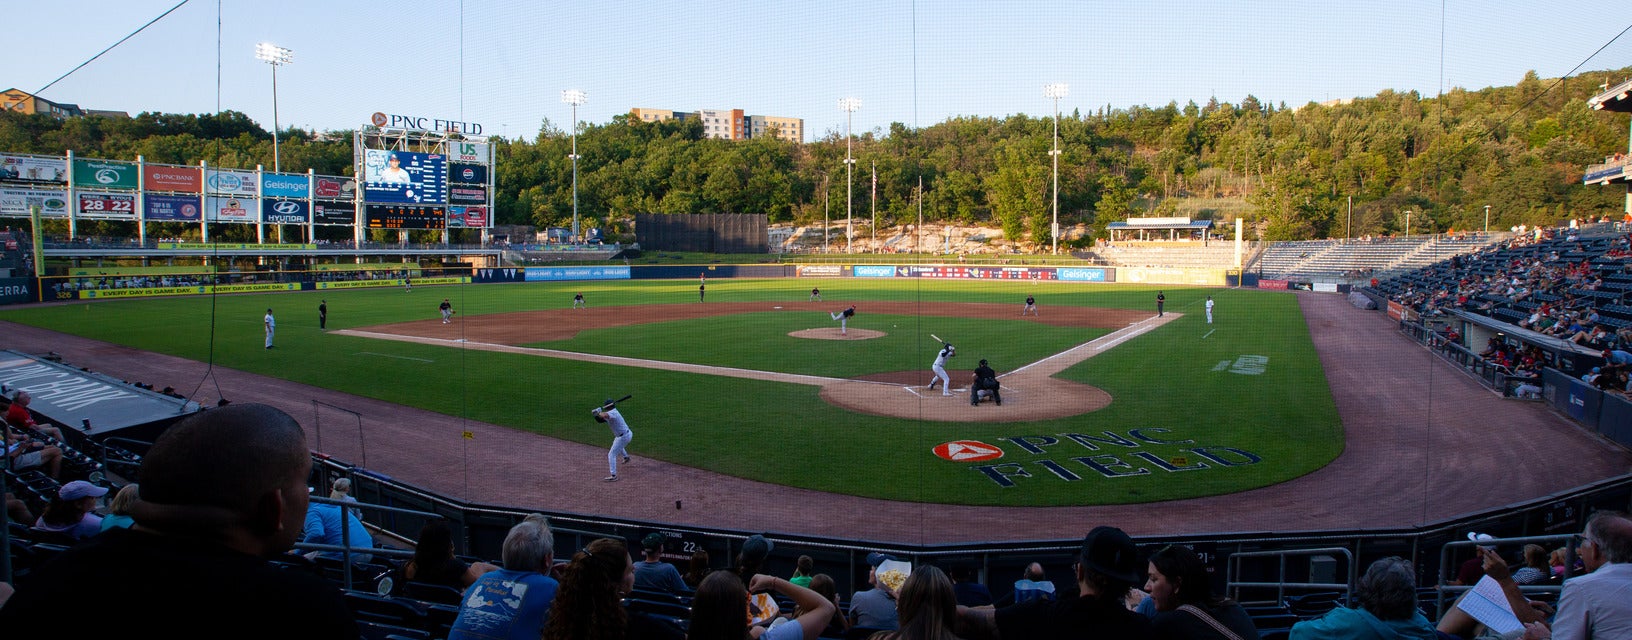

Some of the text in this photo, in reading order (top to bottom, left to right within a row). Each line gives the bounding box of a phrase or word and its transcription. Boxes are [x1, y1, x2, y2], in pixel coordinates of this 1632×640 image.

[391, 114, 482, 135] PNC FIELD
[264, 180, 308, 192] Geisinger
[84, 200, 131, 211] 28 22
[858, 267, 891, 276] Geisinger
[1063, 270, 1100, 280] Geisinger
[18, 376, 140, 412] BANK
[998, 428, 1194, 454] PNC
[968, 446, 1262, 488] FIELD
[683, 541, 696, 552] 22
